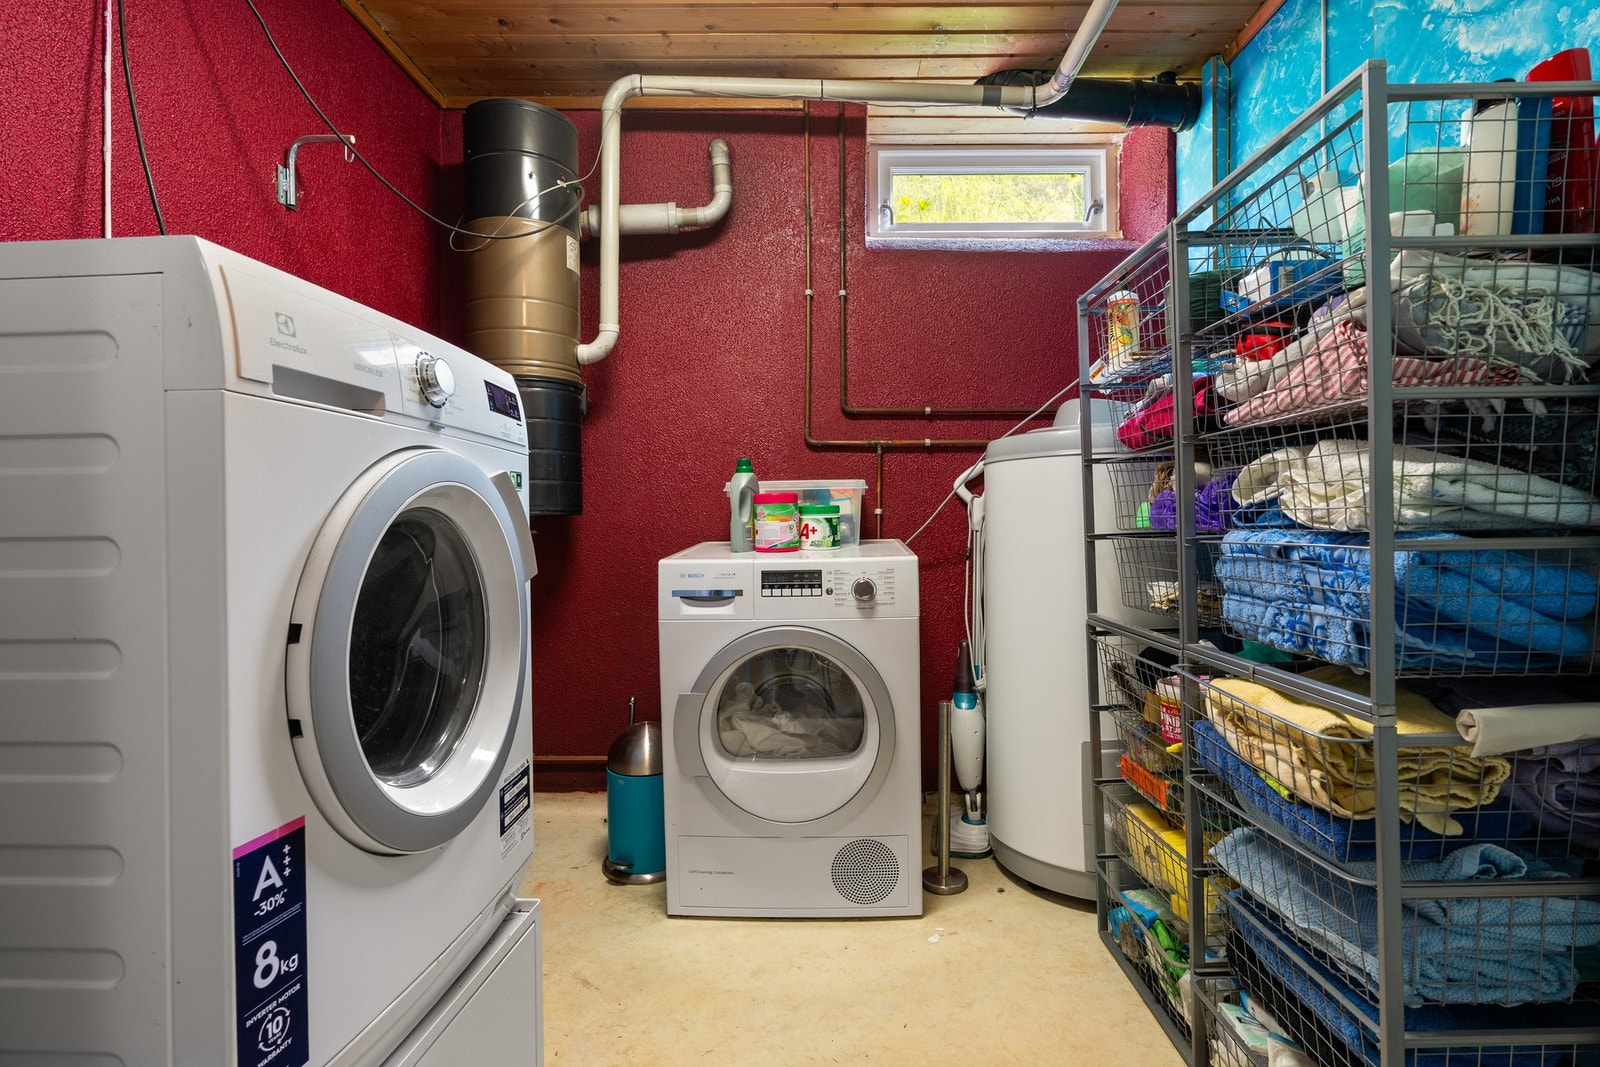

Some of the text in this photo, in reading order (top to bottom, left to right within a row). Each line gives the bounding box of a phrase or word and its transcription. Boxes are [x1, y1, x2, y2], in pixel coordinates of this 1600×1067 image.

[269, 337, 308, 355] Electrolux
[245, 983, 301, 1028] INVERTER MOTOR
[266, 1015, 284, 1040] 10
[257, 1037, 293, 1067] WARRANTY
